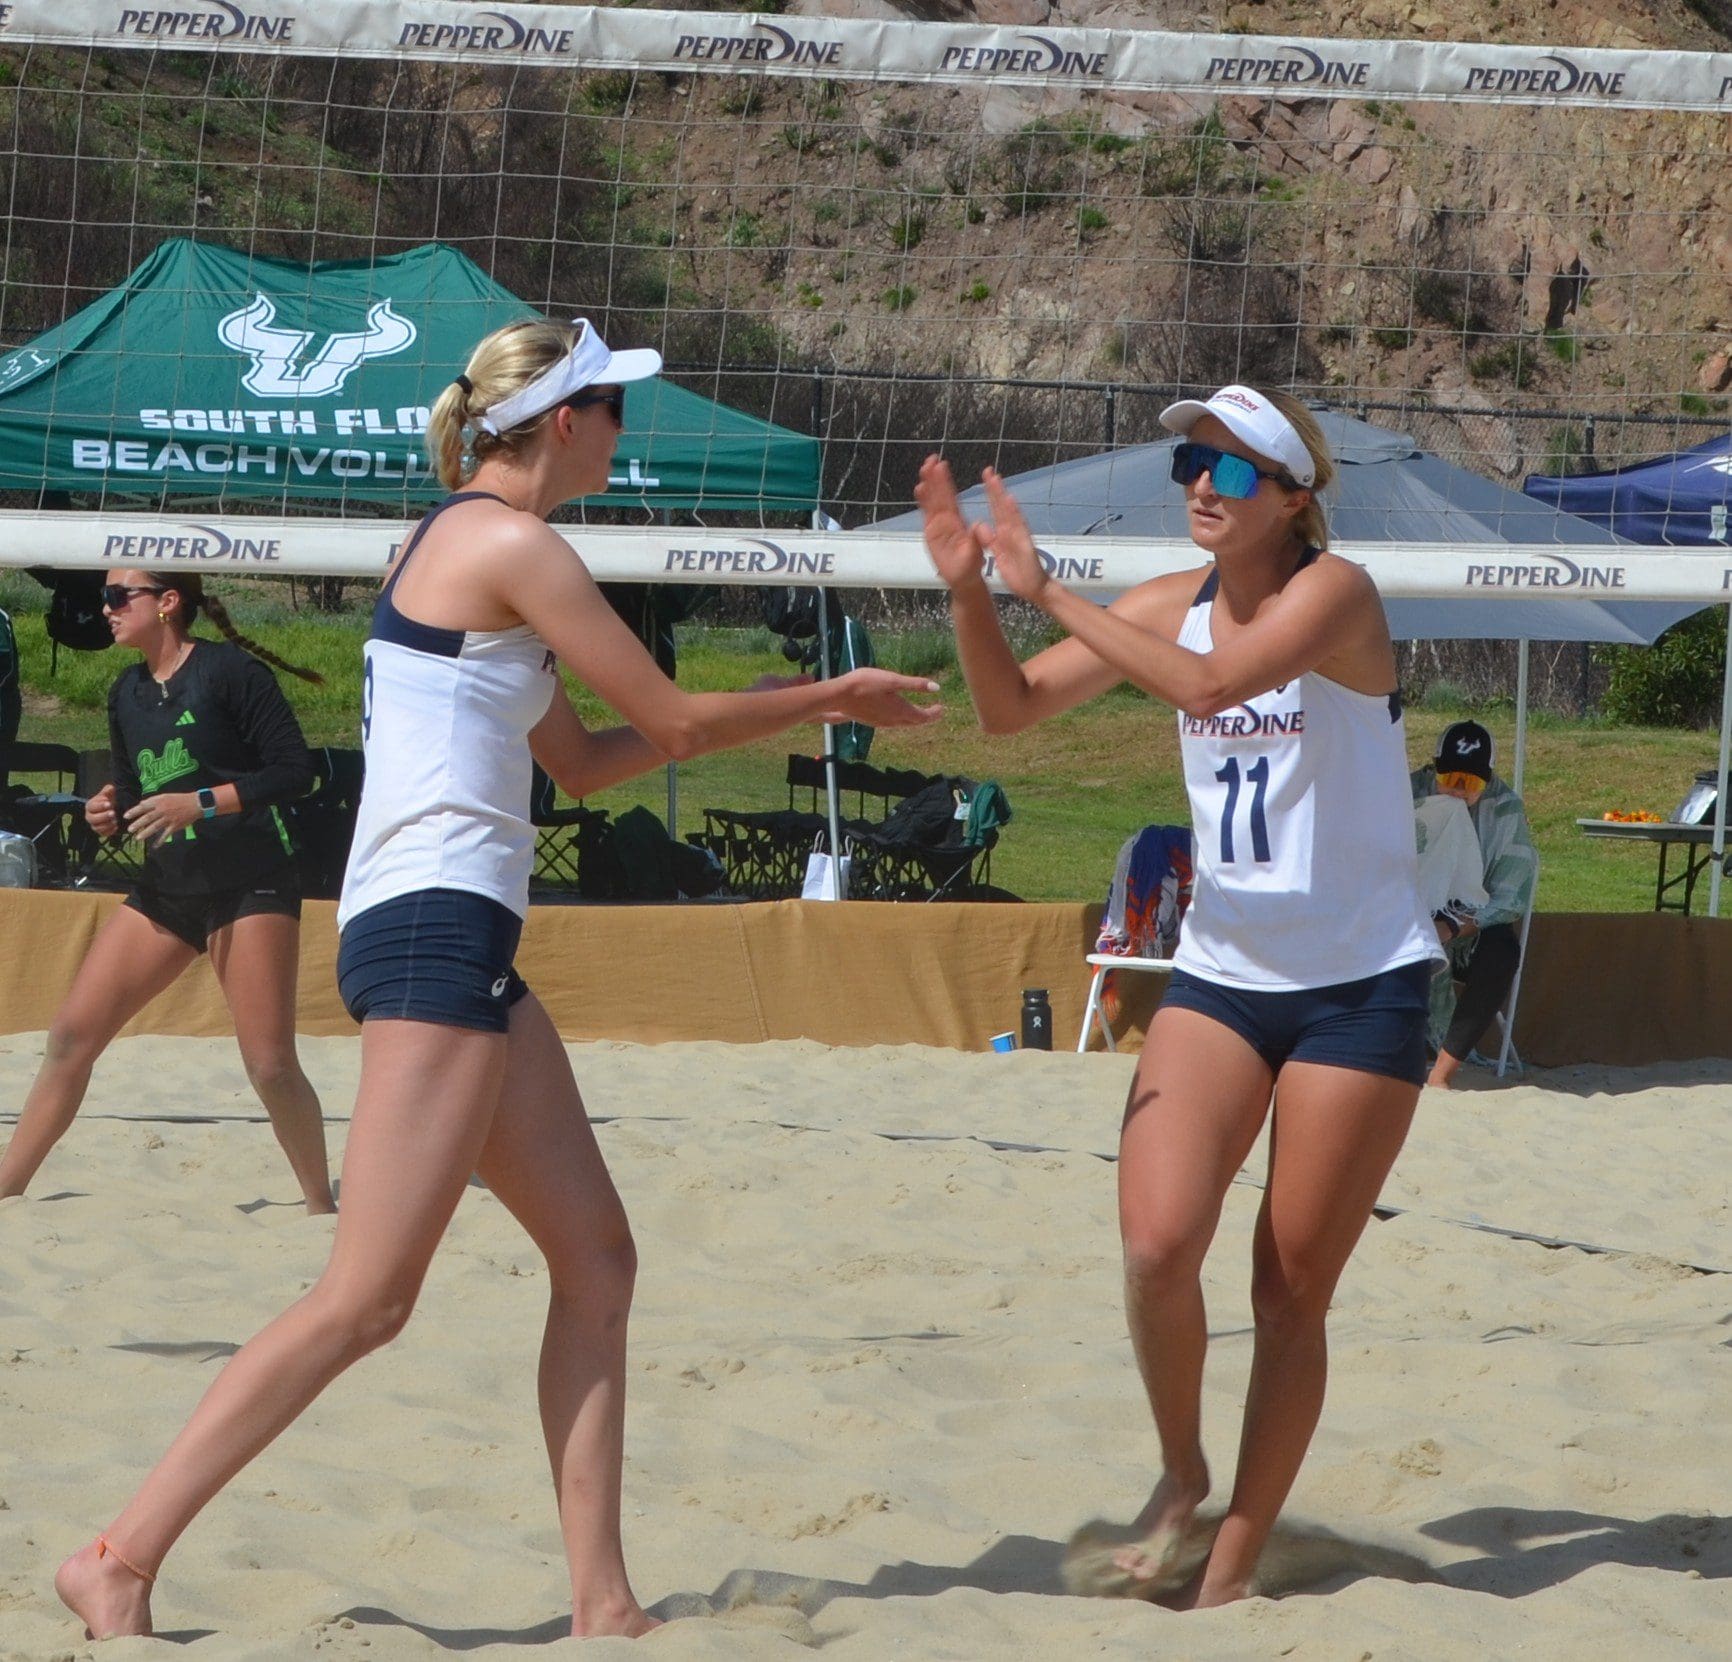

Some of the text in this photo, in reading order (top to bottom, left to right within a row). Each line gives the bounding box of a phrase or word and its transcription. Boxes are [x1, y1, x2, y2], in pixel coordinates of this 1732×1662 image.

[117, 0, 1627, 96] PEPPERDINE PEPPERDINE PEPPERDINE PEPPERDINE PEPPERDINE PEPPERDINE
[139, 408, 317, 435] SOUTH
[72, 438, 277, 474] BEACH
[103, 525, 1627, 589] PEPPERDINE PEPPERDINE PEPPERDINE
[1182, 703, 1305, 738] PEPPERDINE
[137, 737, 200, 794] Bulls
[1213, 756, 1272, 864] 11
